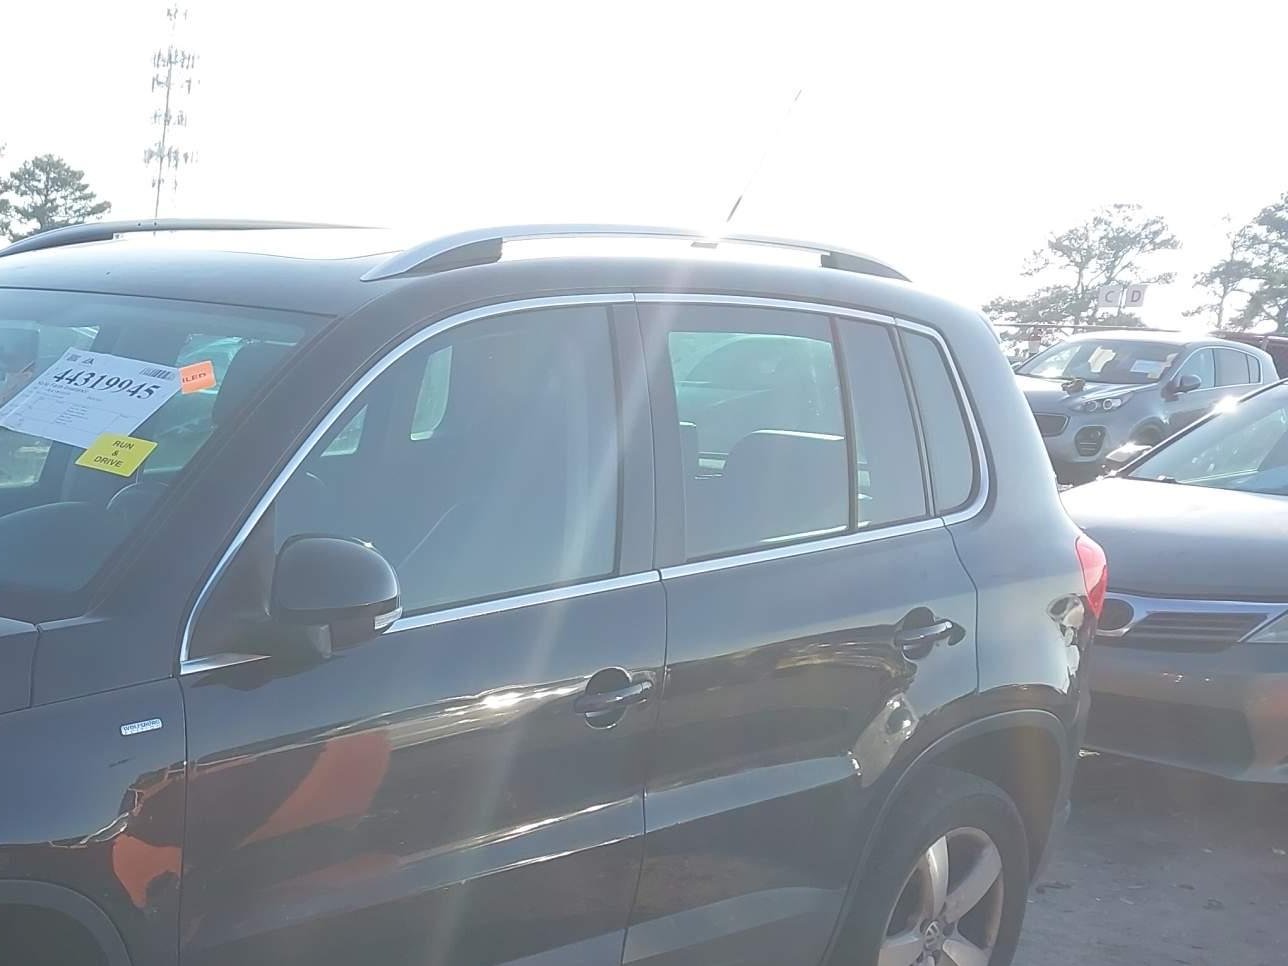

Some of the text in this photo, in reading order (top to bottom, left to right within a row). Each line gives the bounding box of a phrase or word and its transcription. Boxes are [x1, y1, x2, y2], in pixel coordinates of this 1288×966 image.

[1105, 290, 1115, 303] C
[1131, 290, 1142, 303] D
[53, 368, 160, 399] 44319945
[112, 440, 134, 450] RUN
[94, 455, 123, 468] DRIVE
